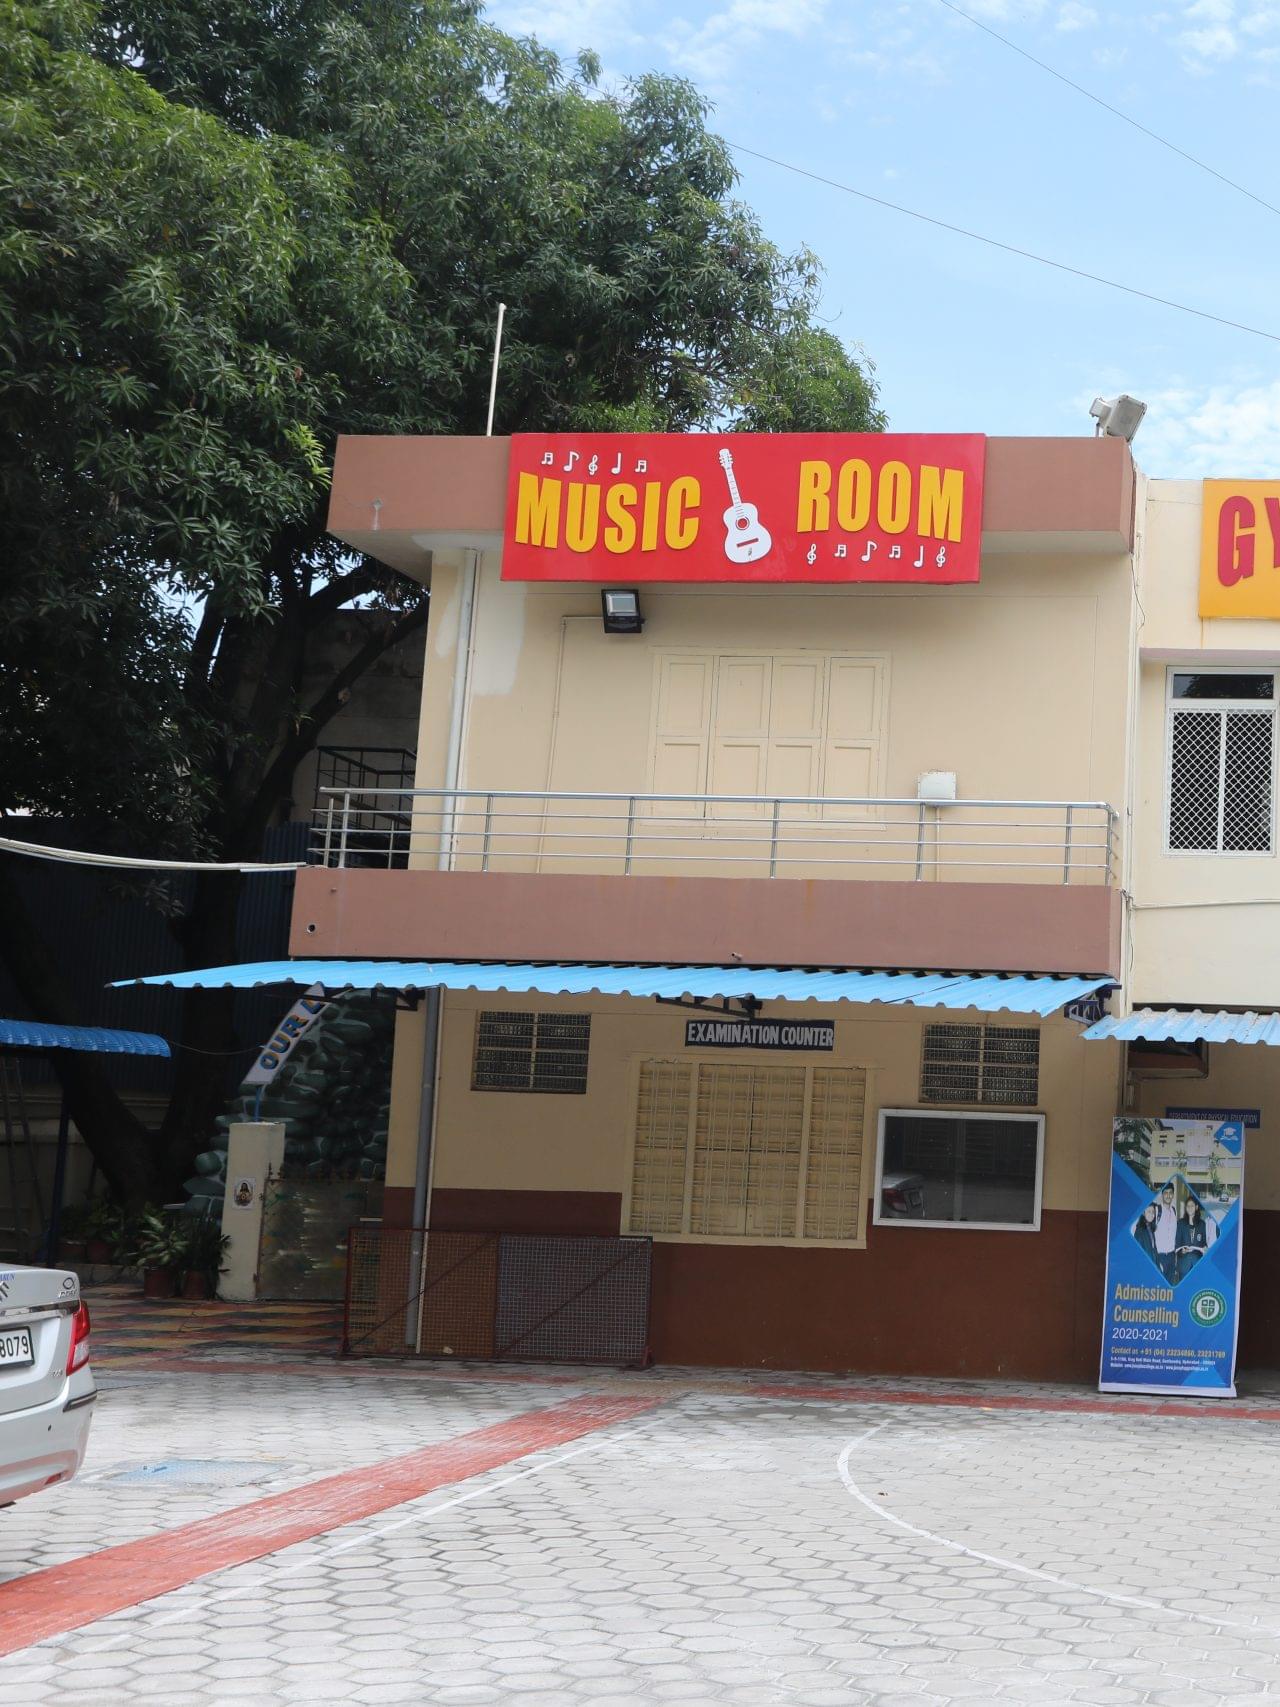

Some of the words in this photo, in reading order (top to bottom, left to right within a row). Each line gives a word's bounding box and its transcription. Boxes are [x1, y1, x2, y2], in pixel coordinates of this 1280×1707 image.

[514, 471, 701, 554] MUSIC
[797, 458, 965, 543] ROOM
[260, 1014, 309, 1069] OUR
[687, 1023, 779, 1045] EXAMINATION
[781, 1026, 834, 1047] COUNTER
[1114, 1283, 1174, 1302] Admission
[1114, 1304, 1179, 1328] Counselling
[1112, 1327, 1168, 1341] 2020-2021
